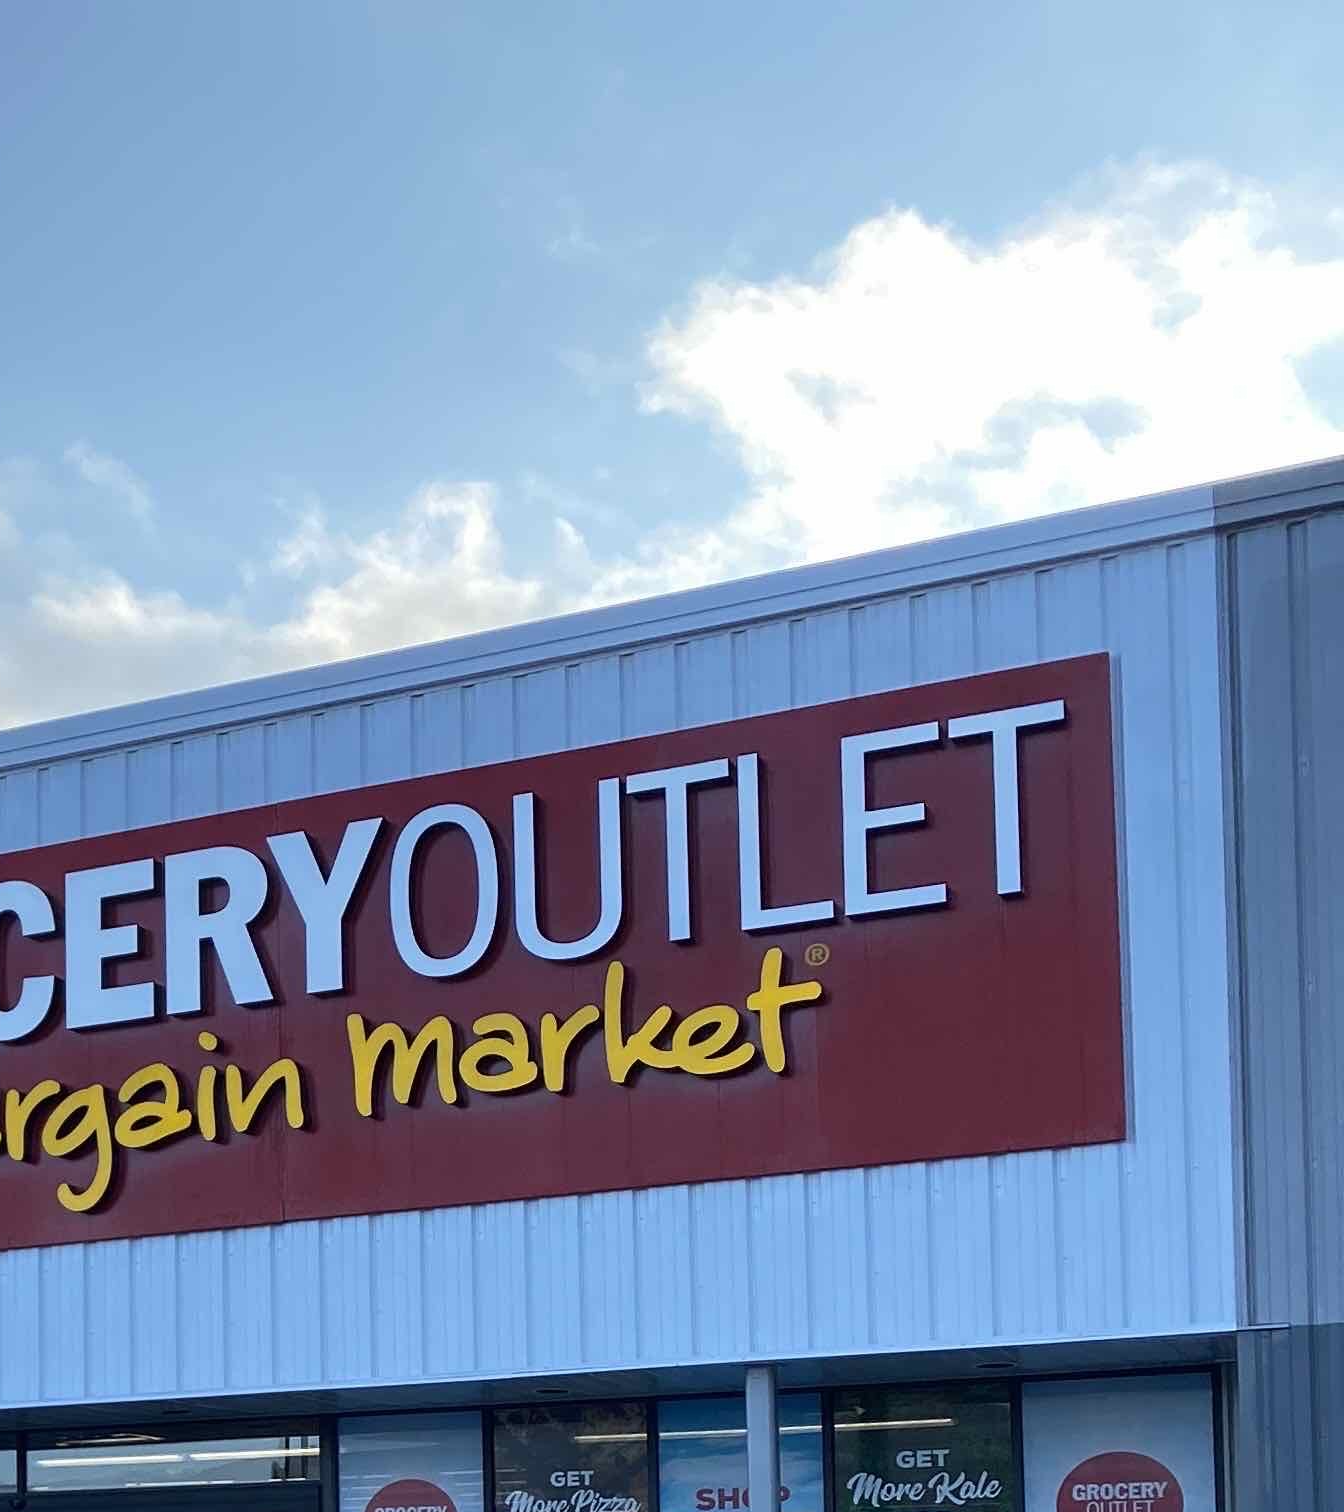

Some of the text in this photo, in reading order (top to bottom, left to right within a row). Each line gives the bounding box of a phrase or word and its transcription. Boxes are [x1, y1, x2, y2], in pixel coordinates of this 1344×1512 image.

[346, 946, 823, 1117] market
[896, 1449, 950, 1468] GET
[550, 1470, 594, 1487] GET
[847, 1470, 1003, 1508] More Kale
[1072, 1481, 1168, 1500] GROCERY
